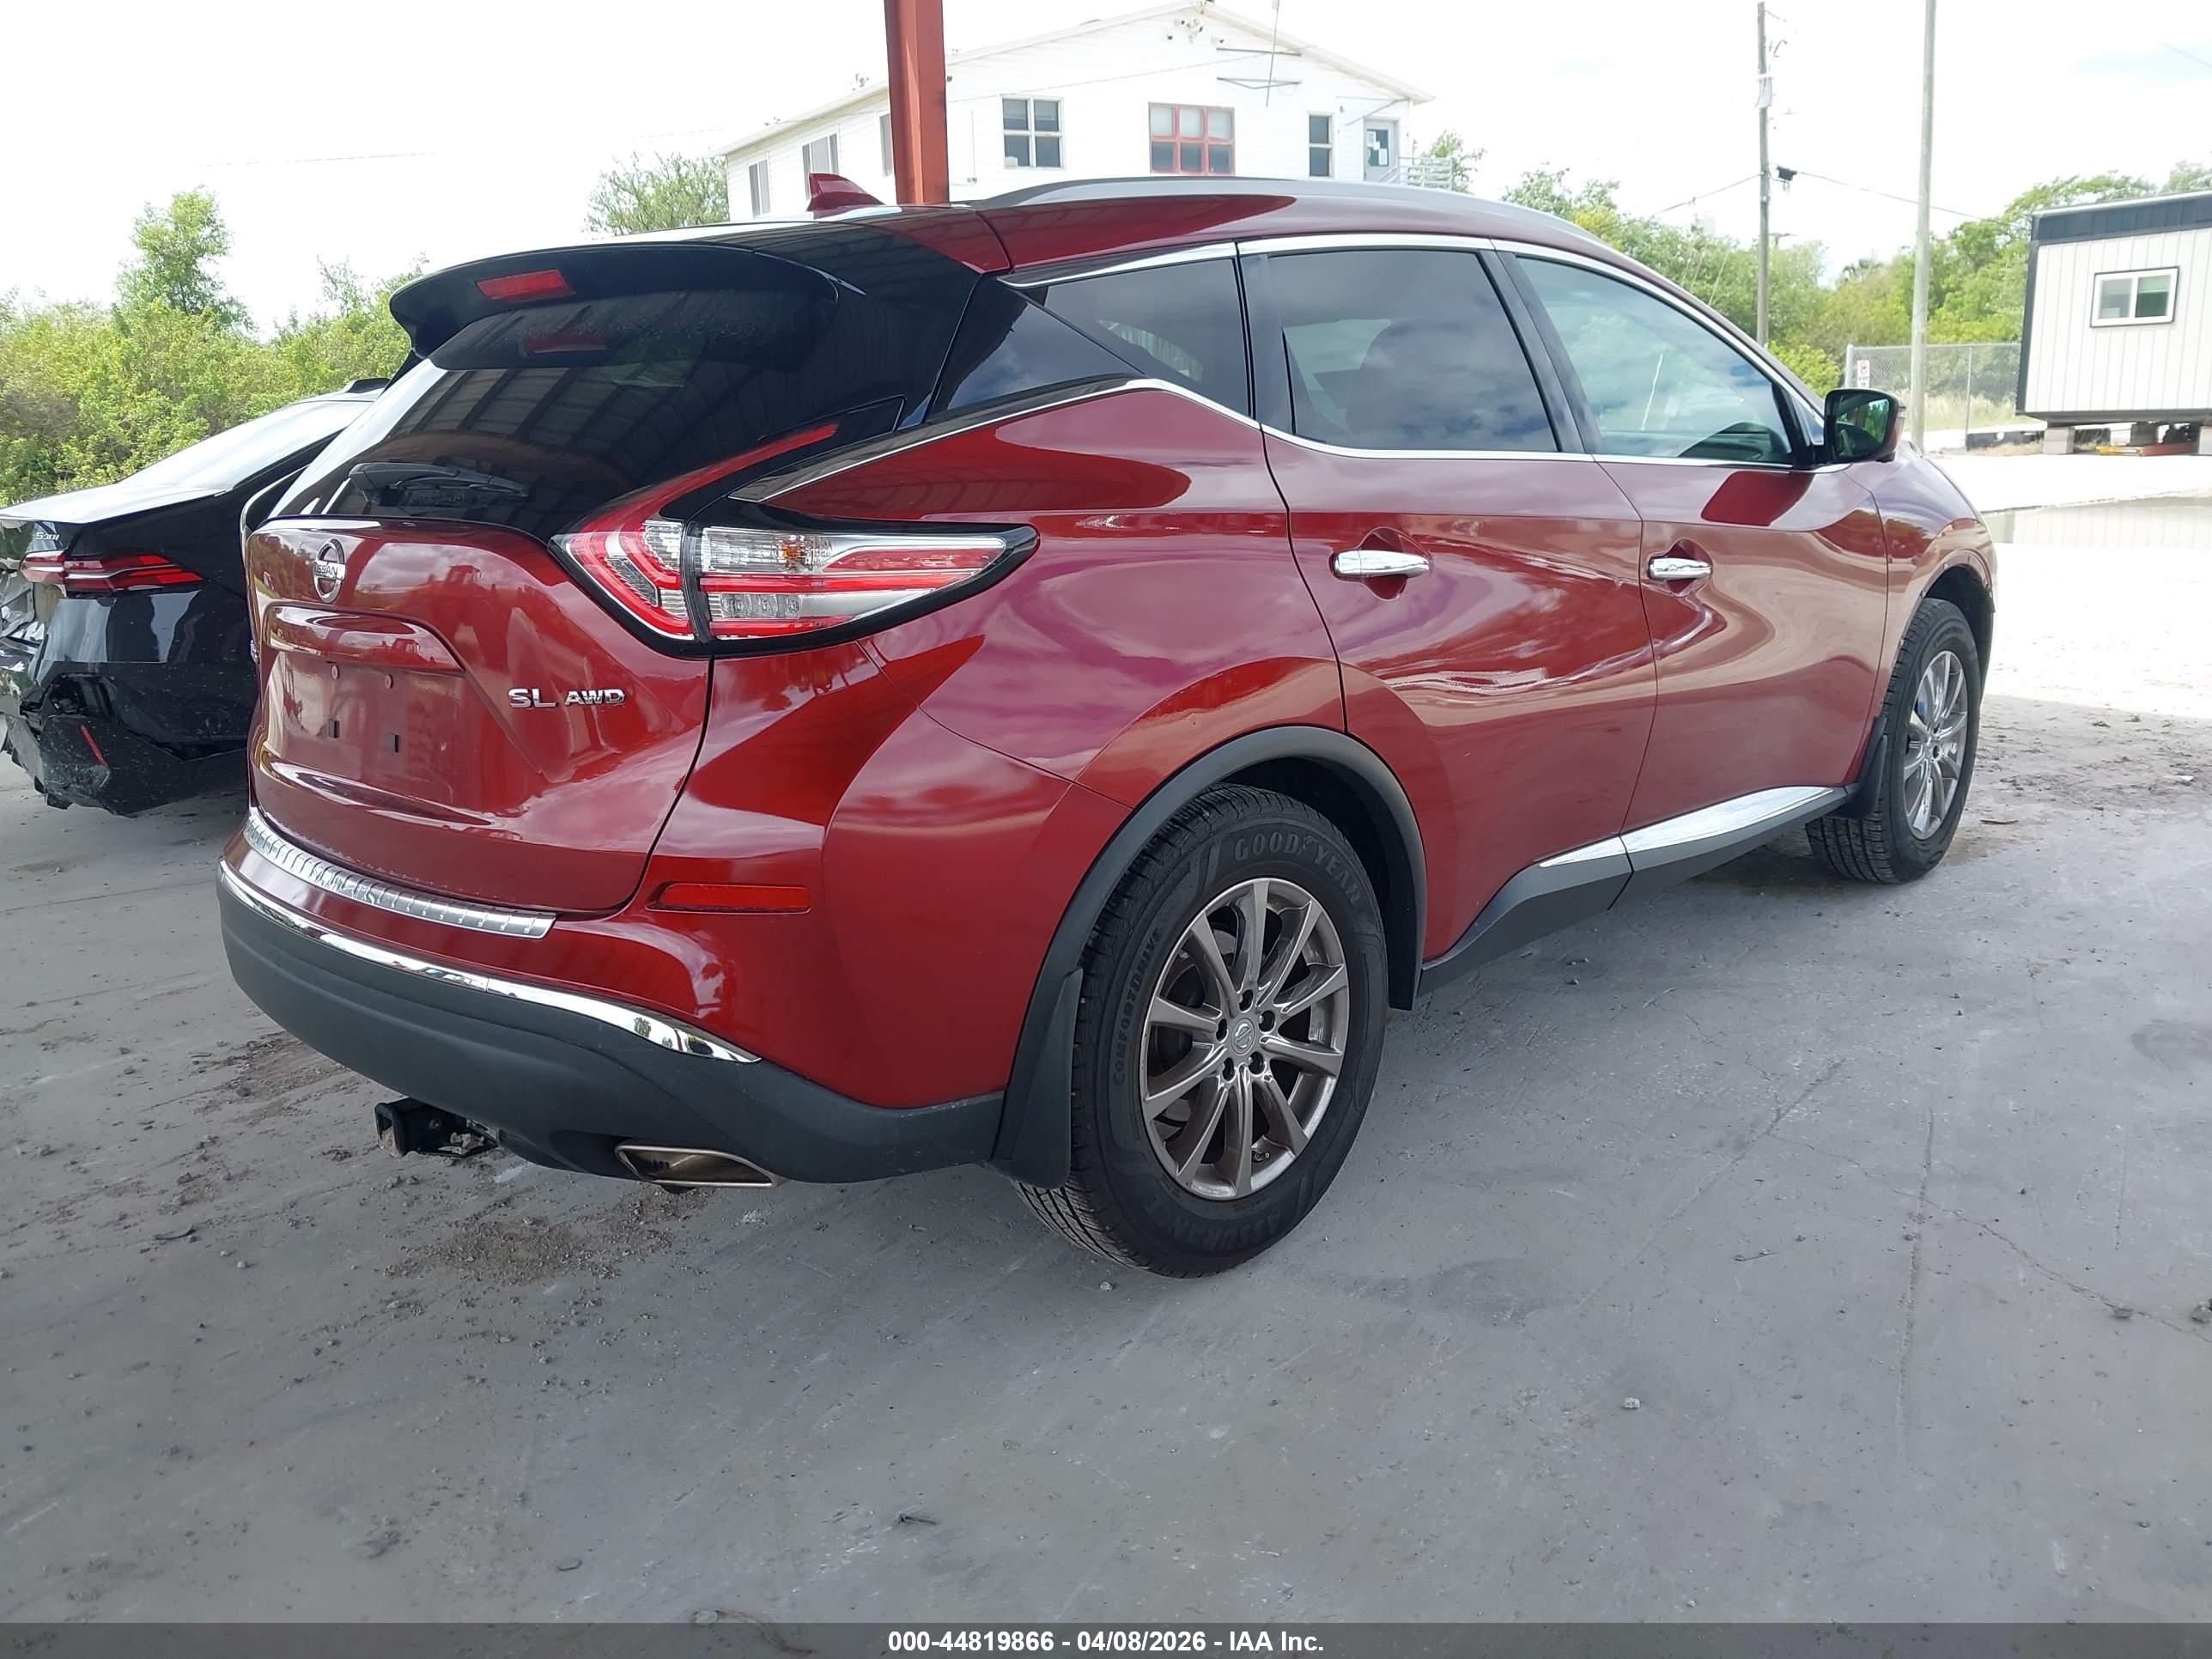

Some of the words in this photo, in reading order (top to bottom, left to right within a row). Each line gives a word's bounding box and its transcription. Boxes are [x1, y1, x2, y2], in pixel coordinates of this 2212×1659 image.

[508, 688, 557, 708] SL
[564, 689, 625, 706] AWD
[1114, 927, 1161, 1087] COMFORTDRIVE
